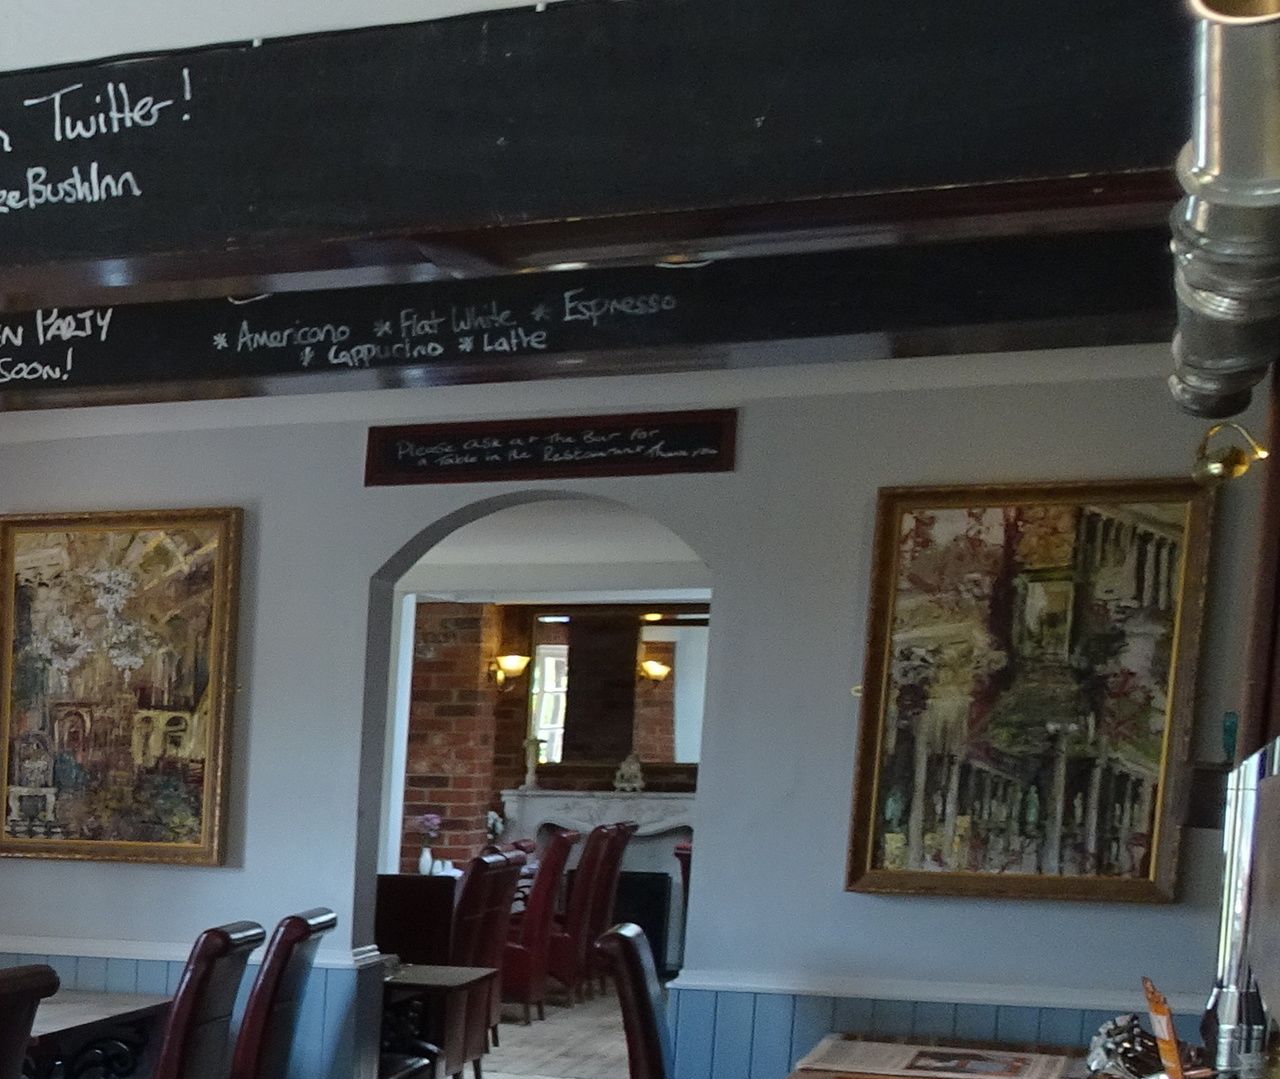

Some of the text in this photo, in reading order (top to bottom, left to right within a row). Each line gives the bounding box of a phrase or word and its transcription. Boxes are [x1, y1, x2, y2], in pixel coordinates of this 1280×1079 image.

[23, 67, 192, 142] Twitter!
[35, 307, 113, 345] PARTY
[237, 287, 677, 353] Americano Flat White Espresso
[482, 326, 548, 353] Latte
